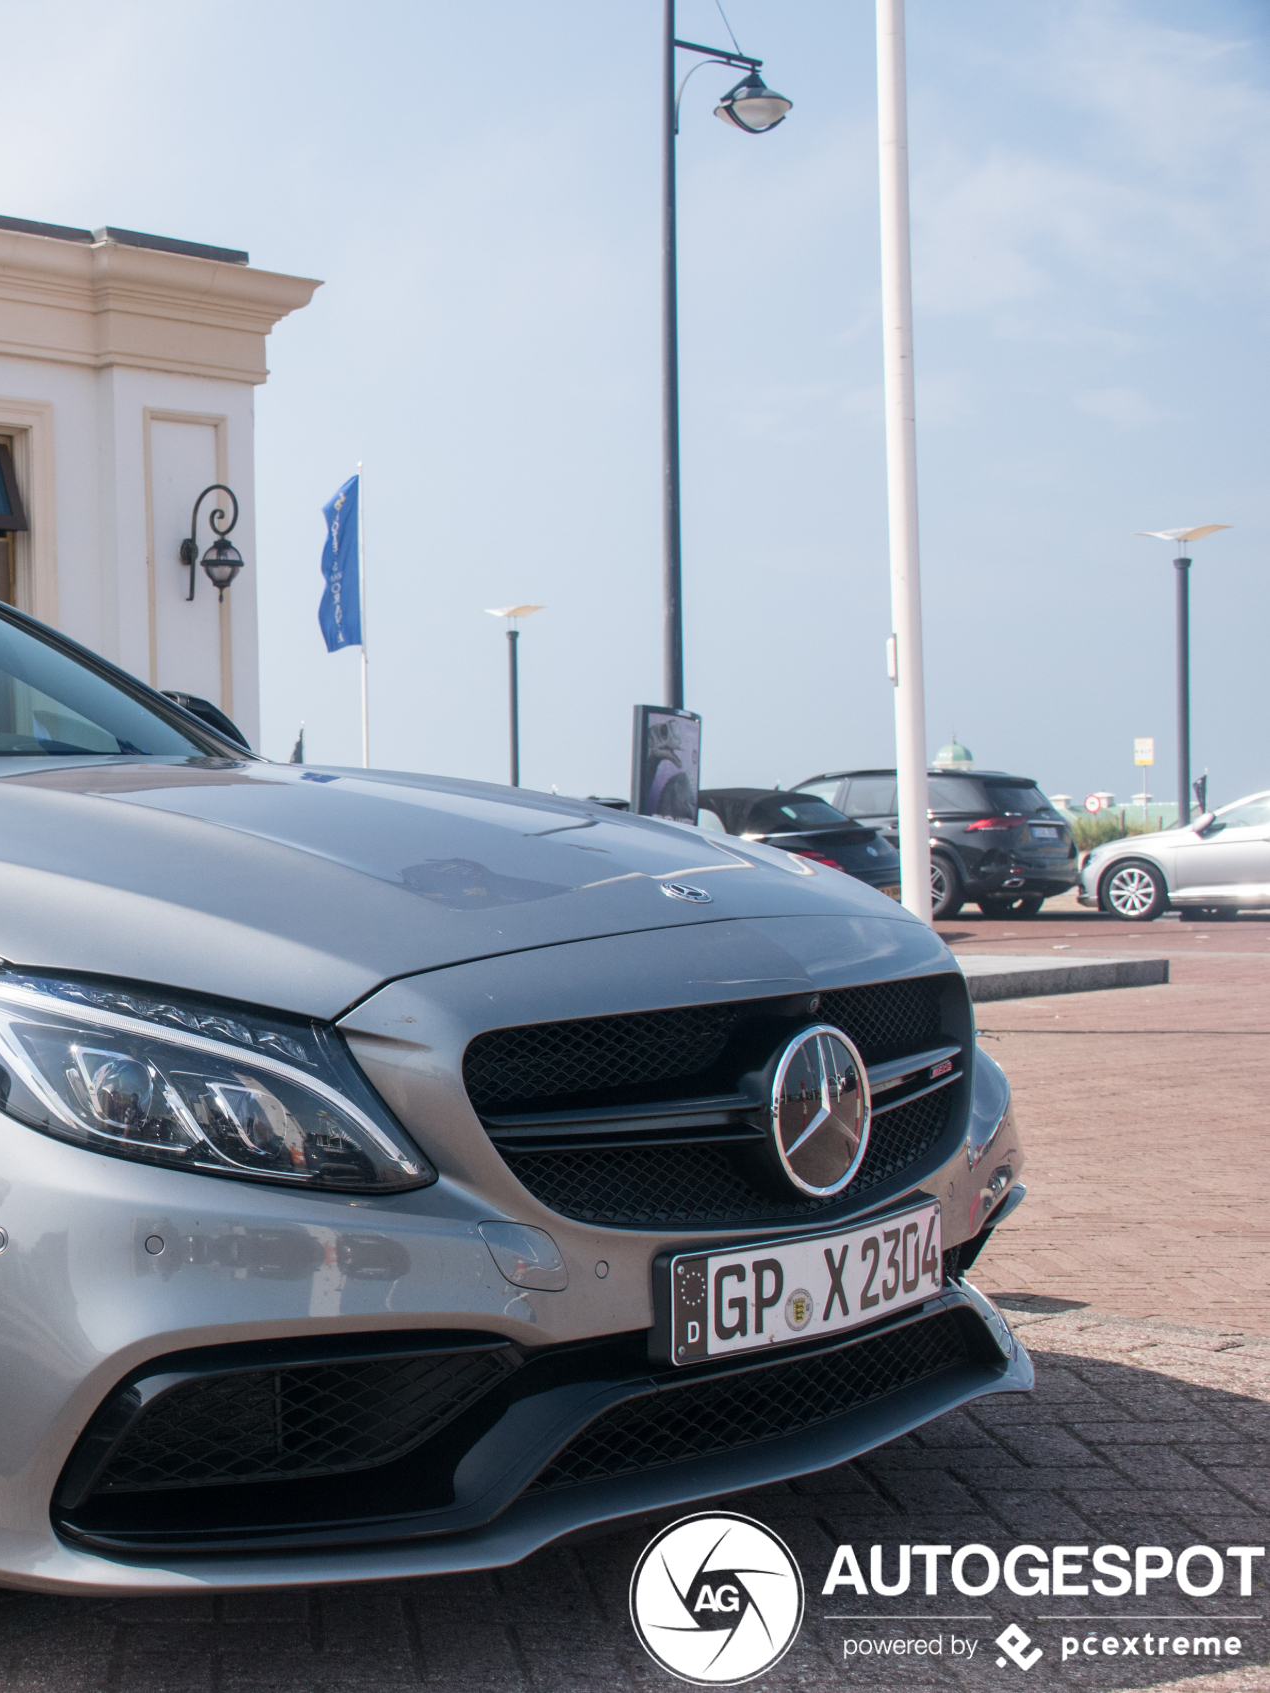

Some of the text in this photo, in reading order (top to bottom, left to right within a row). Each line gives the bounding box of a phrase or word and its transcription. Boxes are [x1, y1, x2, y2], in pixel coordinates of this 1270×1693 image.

[714, 1258, 784, 1341] GP
[822, 1244, 849, 1321] X
[860, 1215, 938, 1311] 2304
[687, 1321, 700, 1343] D
